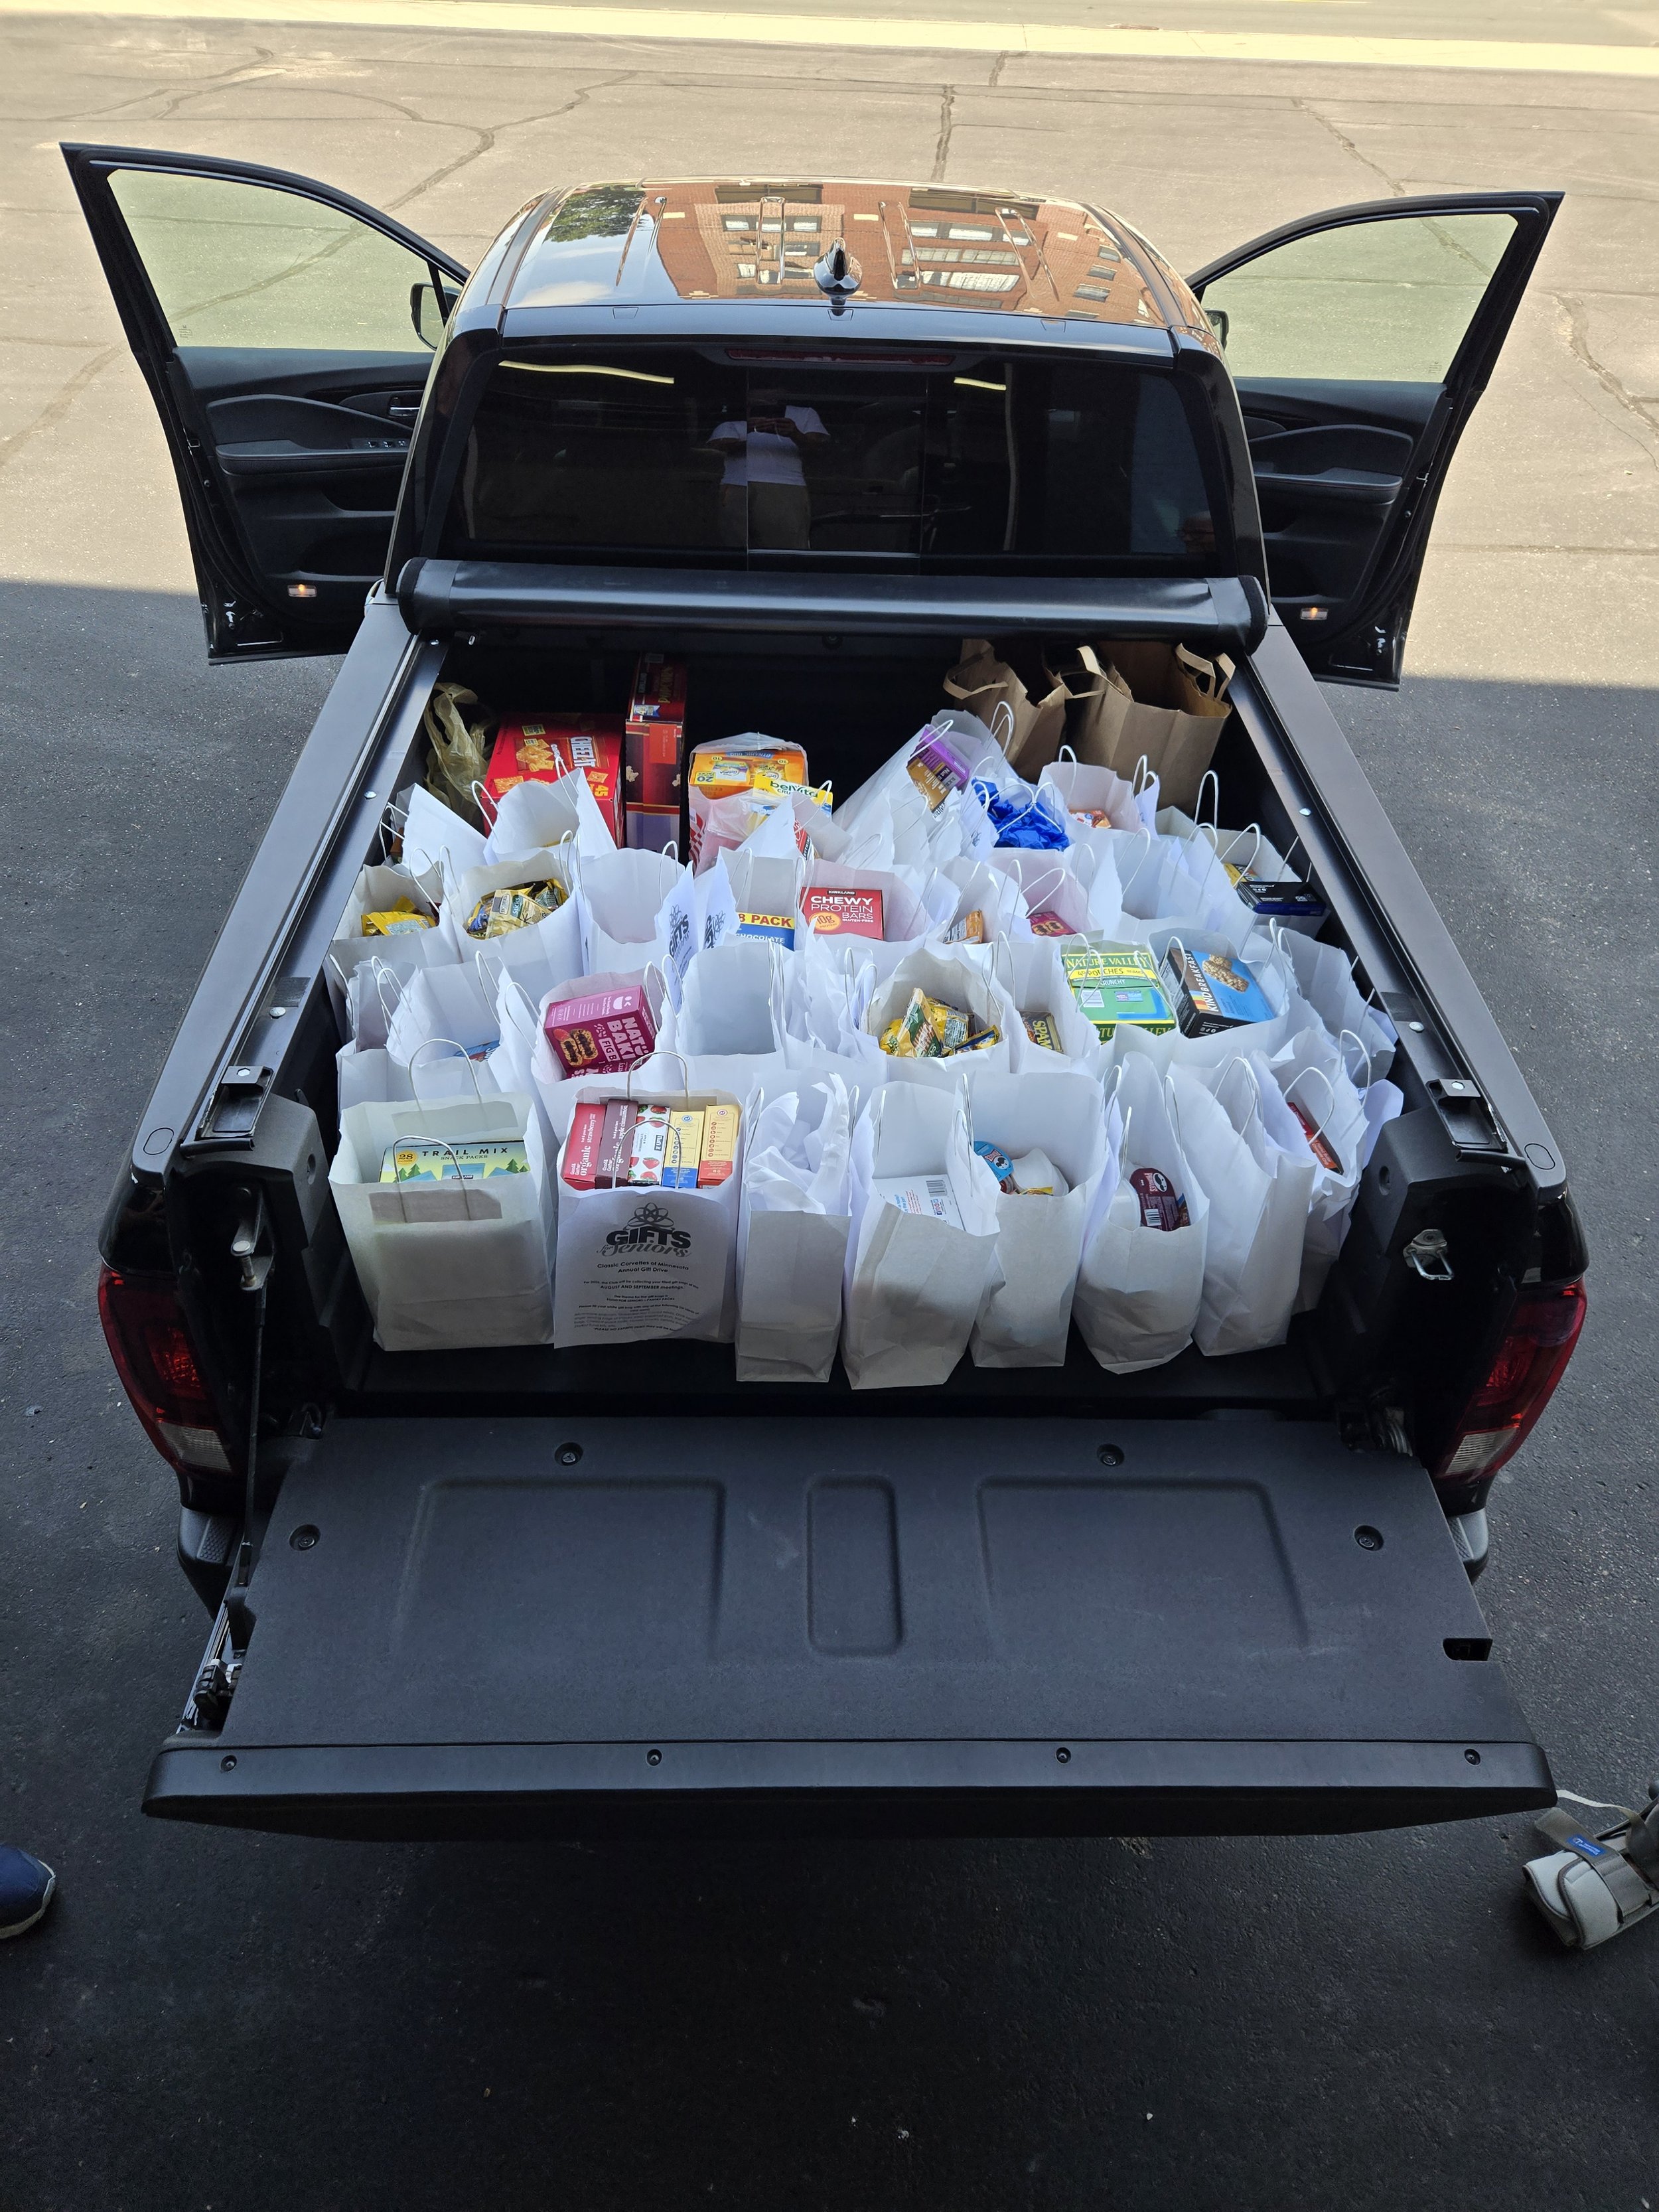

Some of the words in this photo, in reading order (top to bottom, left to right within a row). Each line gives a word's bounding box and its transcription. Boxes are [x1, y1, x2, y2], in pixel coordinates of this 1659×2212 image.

[595, 784, 609, 797] 45
[770, 781, 818, 798] belVita
[512, 897, 521, 915] Sticks
[810, 896, 873, 905] CHEWY
[811, 903, 873, 913] PROTEIN
[751, 915, 792, 928] PACK
[816, 915, 835, 925] 10g
[669, 914, 689, 958] GIFTS
[736, 934, 786, 944] CHOCOLATE
[1066, 958, 1108, 969] NATURE
[1108, 956, 1147, 968] VALLEY
[1184, 953, 1210, 992] BREAKFAST
[1033, 1020, 1052, 1049] SPAM
[601, 1041, 613, 1054] FIG
[580, 1145, 593, 1177] organic
[587, 1119, 596, 1143] strawberry
[606, 1226, 691, 1249] GIFTS
[601, 1242, 692, 1258] Seniors
[658, 1262, 689, 1270] Minnesota
